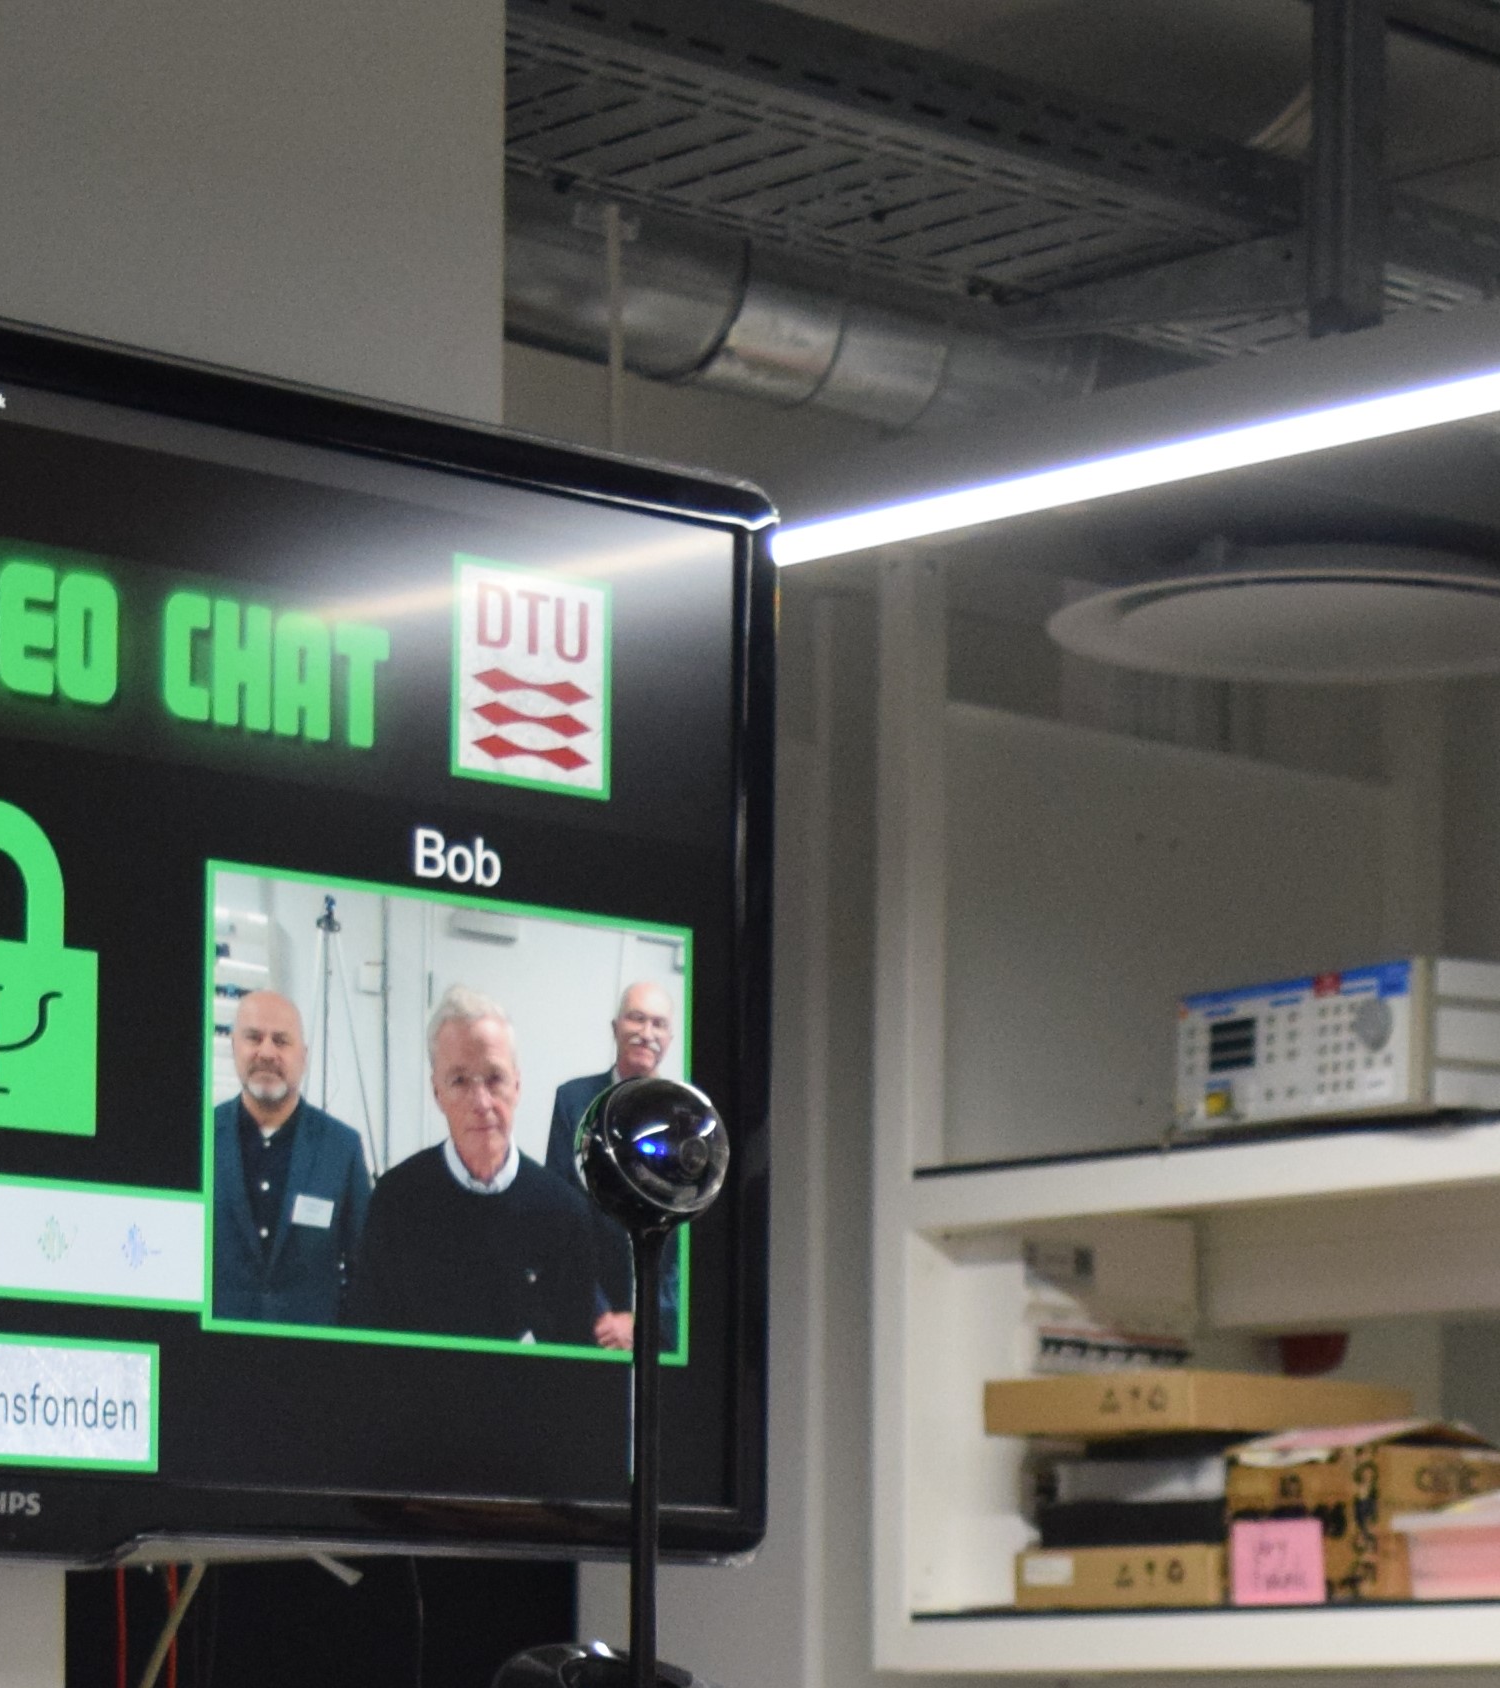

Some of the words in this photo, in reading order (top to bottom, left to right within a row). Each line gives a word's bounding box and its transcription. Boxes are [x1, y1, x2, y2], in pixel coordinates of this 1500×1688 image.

[476, 581, 590, 663] DTU
[163, 591, 391, 748] CHAT
[413, 827, 502, 888] Bob
